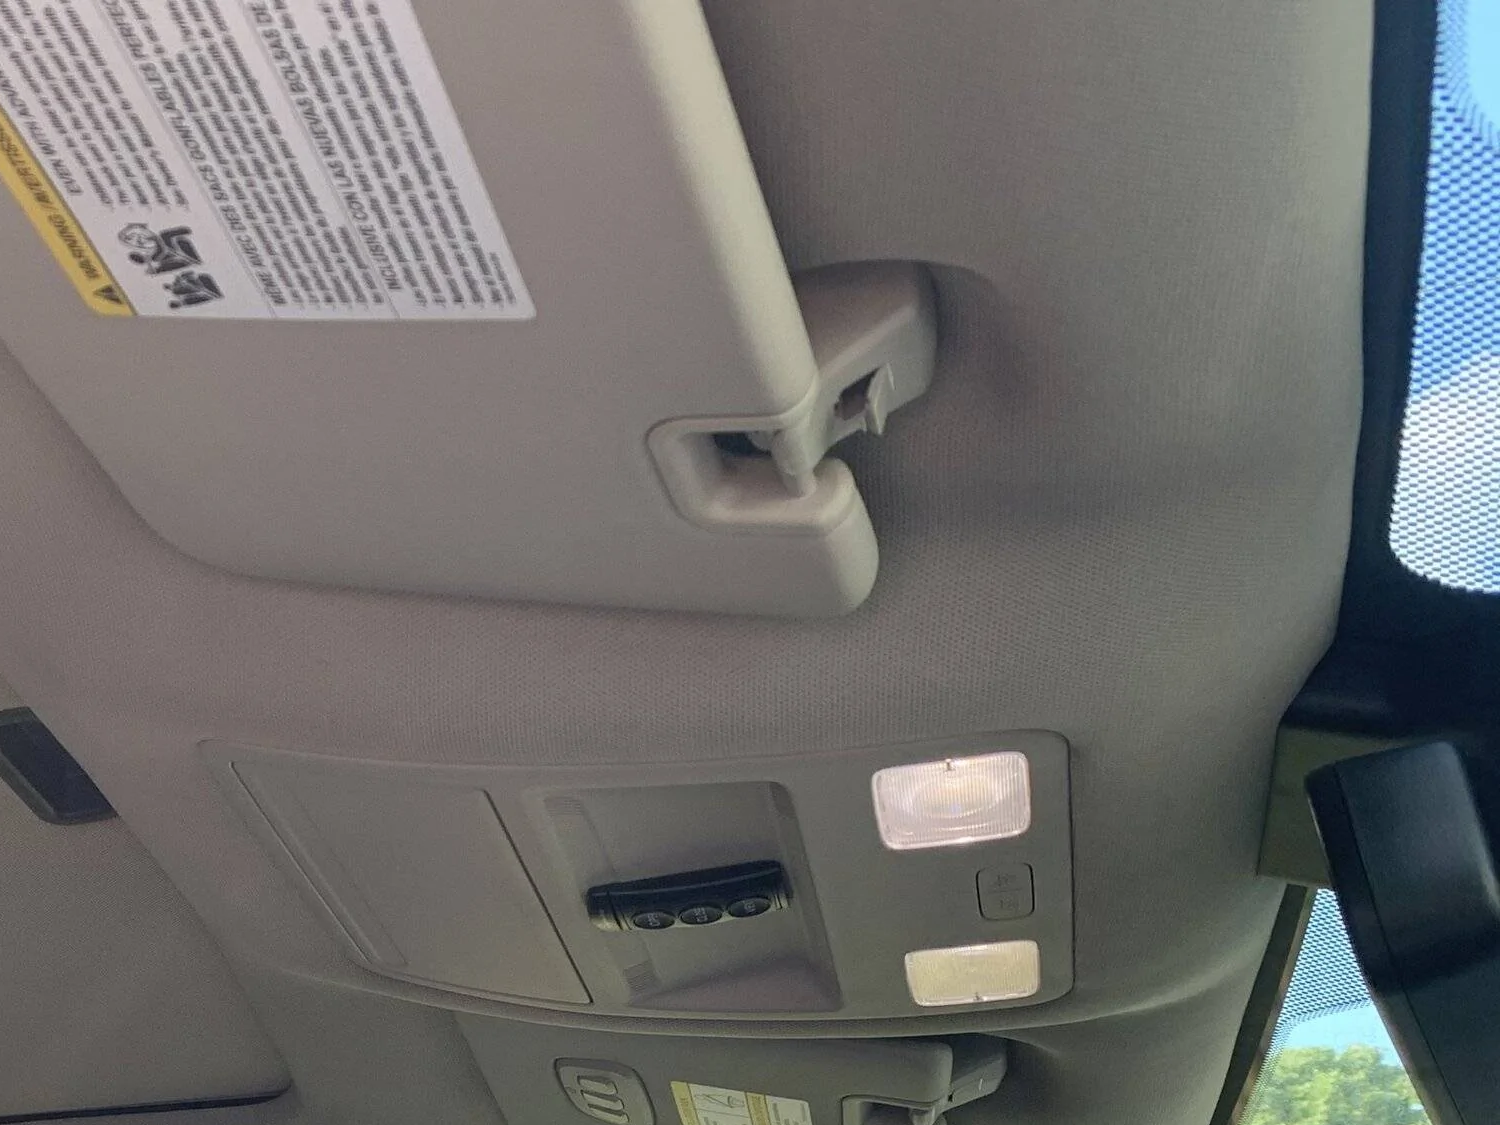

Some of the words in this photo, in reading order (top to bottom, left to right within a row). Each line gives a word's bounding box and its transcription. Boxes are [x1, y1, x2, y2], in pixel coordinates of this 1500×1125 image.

[247, 2, 274, 22] DE
[260, 28, 307, 92] BOLSAS
[136, 62, 206, 159] GONFLABLES
[294, 98, 337, 155] NUEVAS
[21, 121, 58, 154] WITH
[46, 159, 83, 194] EVEN
[194, 165, 229, 200] SACS
[325, 160, 353, 186] LAS
[217, 205, 246, 230] DES
[340, 191, 369, 220] CON
[45, 214, 104, 280] WARNING
[234, 235, 266, 266] AVEC
[356, 224, 402, 289] INCLUSIVE
